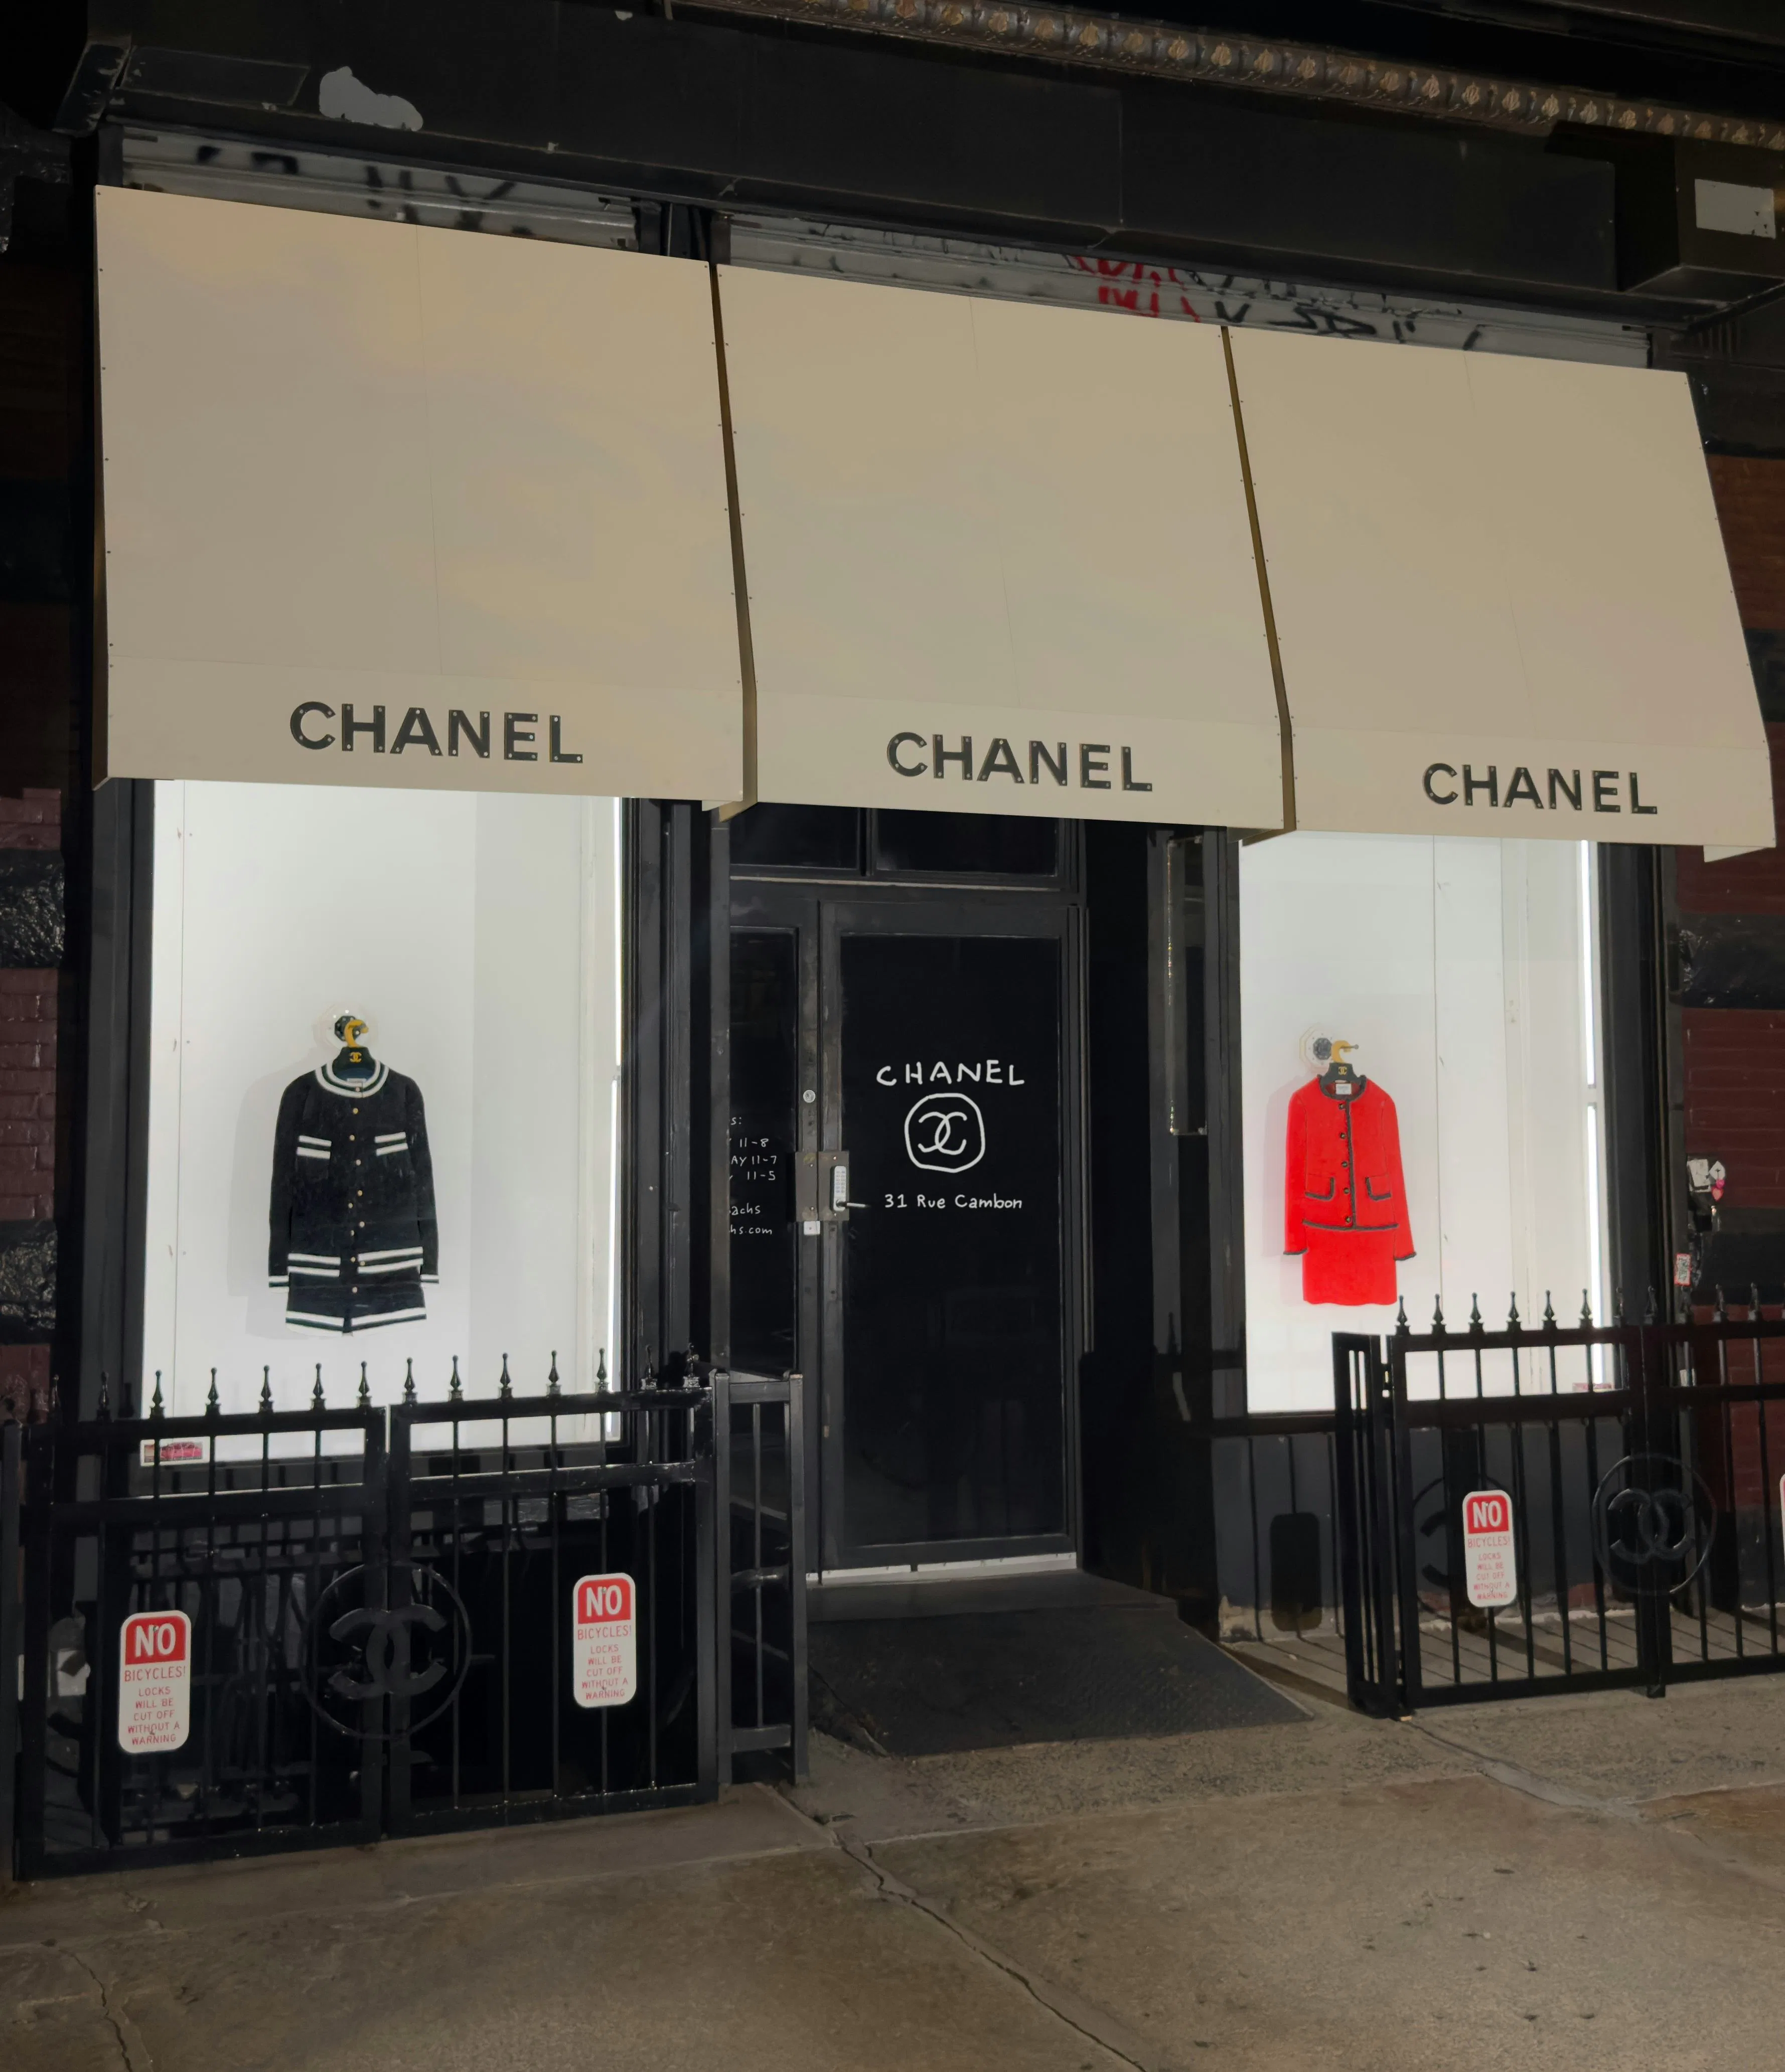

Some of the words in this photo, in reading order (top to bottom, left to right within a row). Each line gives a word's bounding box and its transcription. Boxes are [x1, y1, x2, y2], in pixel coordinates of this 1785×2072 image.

[290, 701, 583, 763] CHANEL
[886, 731, 1153, 792] CHANEL
[1422, 762, 1658, 814] CHANEL
[876, 1059, 1025, 1086] CHANEL
[730, 1117, 741, 1125] s:
[739, 1137, 769, 1148] 11-8
[730, 1155, 747, 1167] AY
[752, 1155, 777, 1165] 11-7
[747, 1171, 776, 1180] 11-5
[885, 1194, 907, 1208] 31
[917, 1194, 946, 1209] Rue
[955, 1193, 1022, 1208] Cambon
[729, 1203, 761, 1215] achs
[729, 1224, 772, 1234] hs.com
[1473, 1501, 1502, 1528] NO
[1478, 1552, 1501, 1561] LOCKS
[1473, 1582, 1502, 1590] WITHOUT
[586, 1585, 622, 1617] NO
[1477, 1591, 1508, 1600] WARNING
[577, 1625, 632, 1640] BICYCLES!
[135, 1623, 176, 1657] NO
[590, 1644, 619, 1654] LOCKS
[588, 1657, 607, 1666] WILL
[612, 1655, 622, 1663] BE
[124, 1666, 186, 1682] BICYCLES!
[586, 1668, 603, 1677] CUT
[607, 1666, 623, 1675] OFF
[582, 1679, 619, 1689] WITHOUT
[138, 1686, 171, 1697] LOCKS
[585, 1689, 625, 1700] WARNING
[135, 1699, 157, 1708] WILL
[162, 1698, 174, 1706] BE
[133, 1711, 152, 1721] CUT
[157, 1709, 175, 1719] OFF
[127, 1723, 169, 1734] WITHOUT
[174, 1721, 180, 1729] A
[132, 1734, 176, 1745] WARNING
